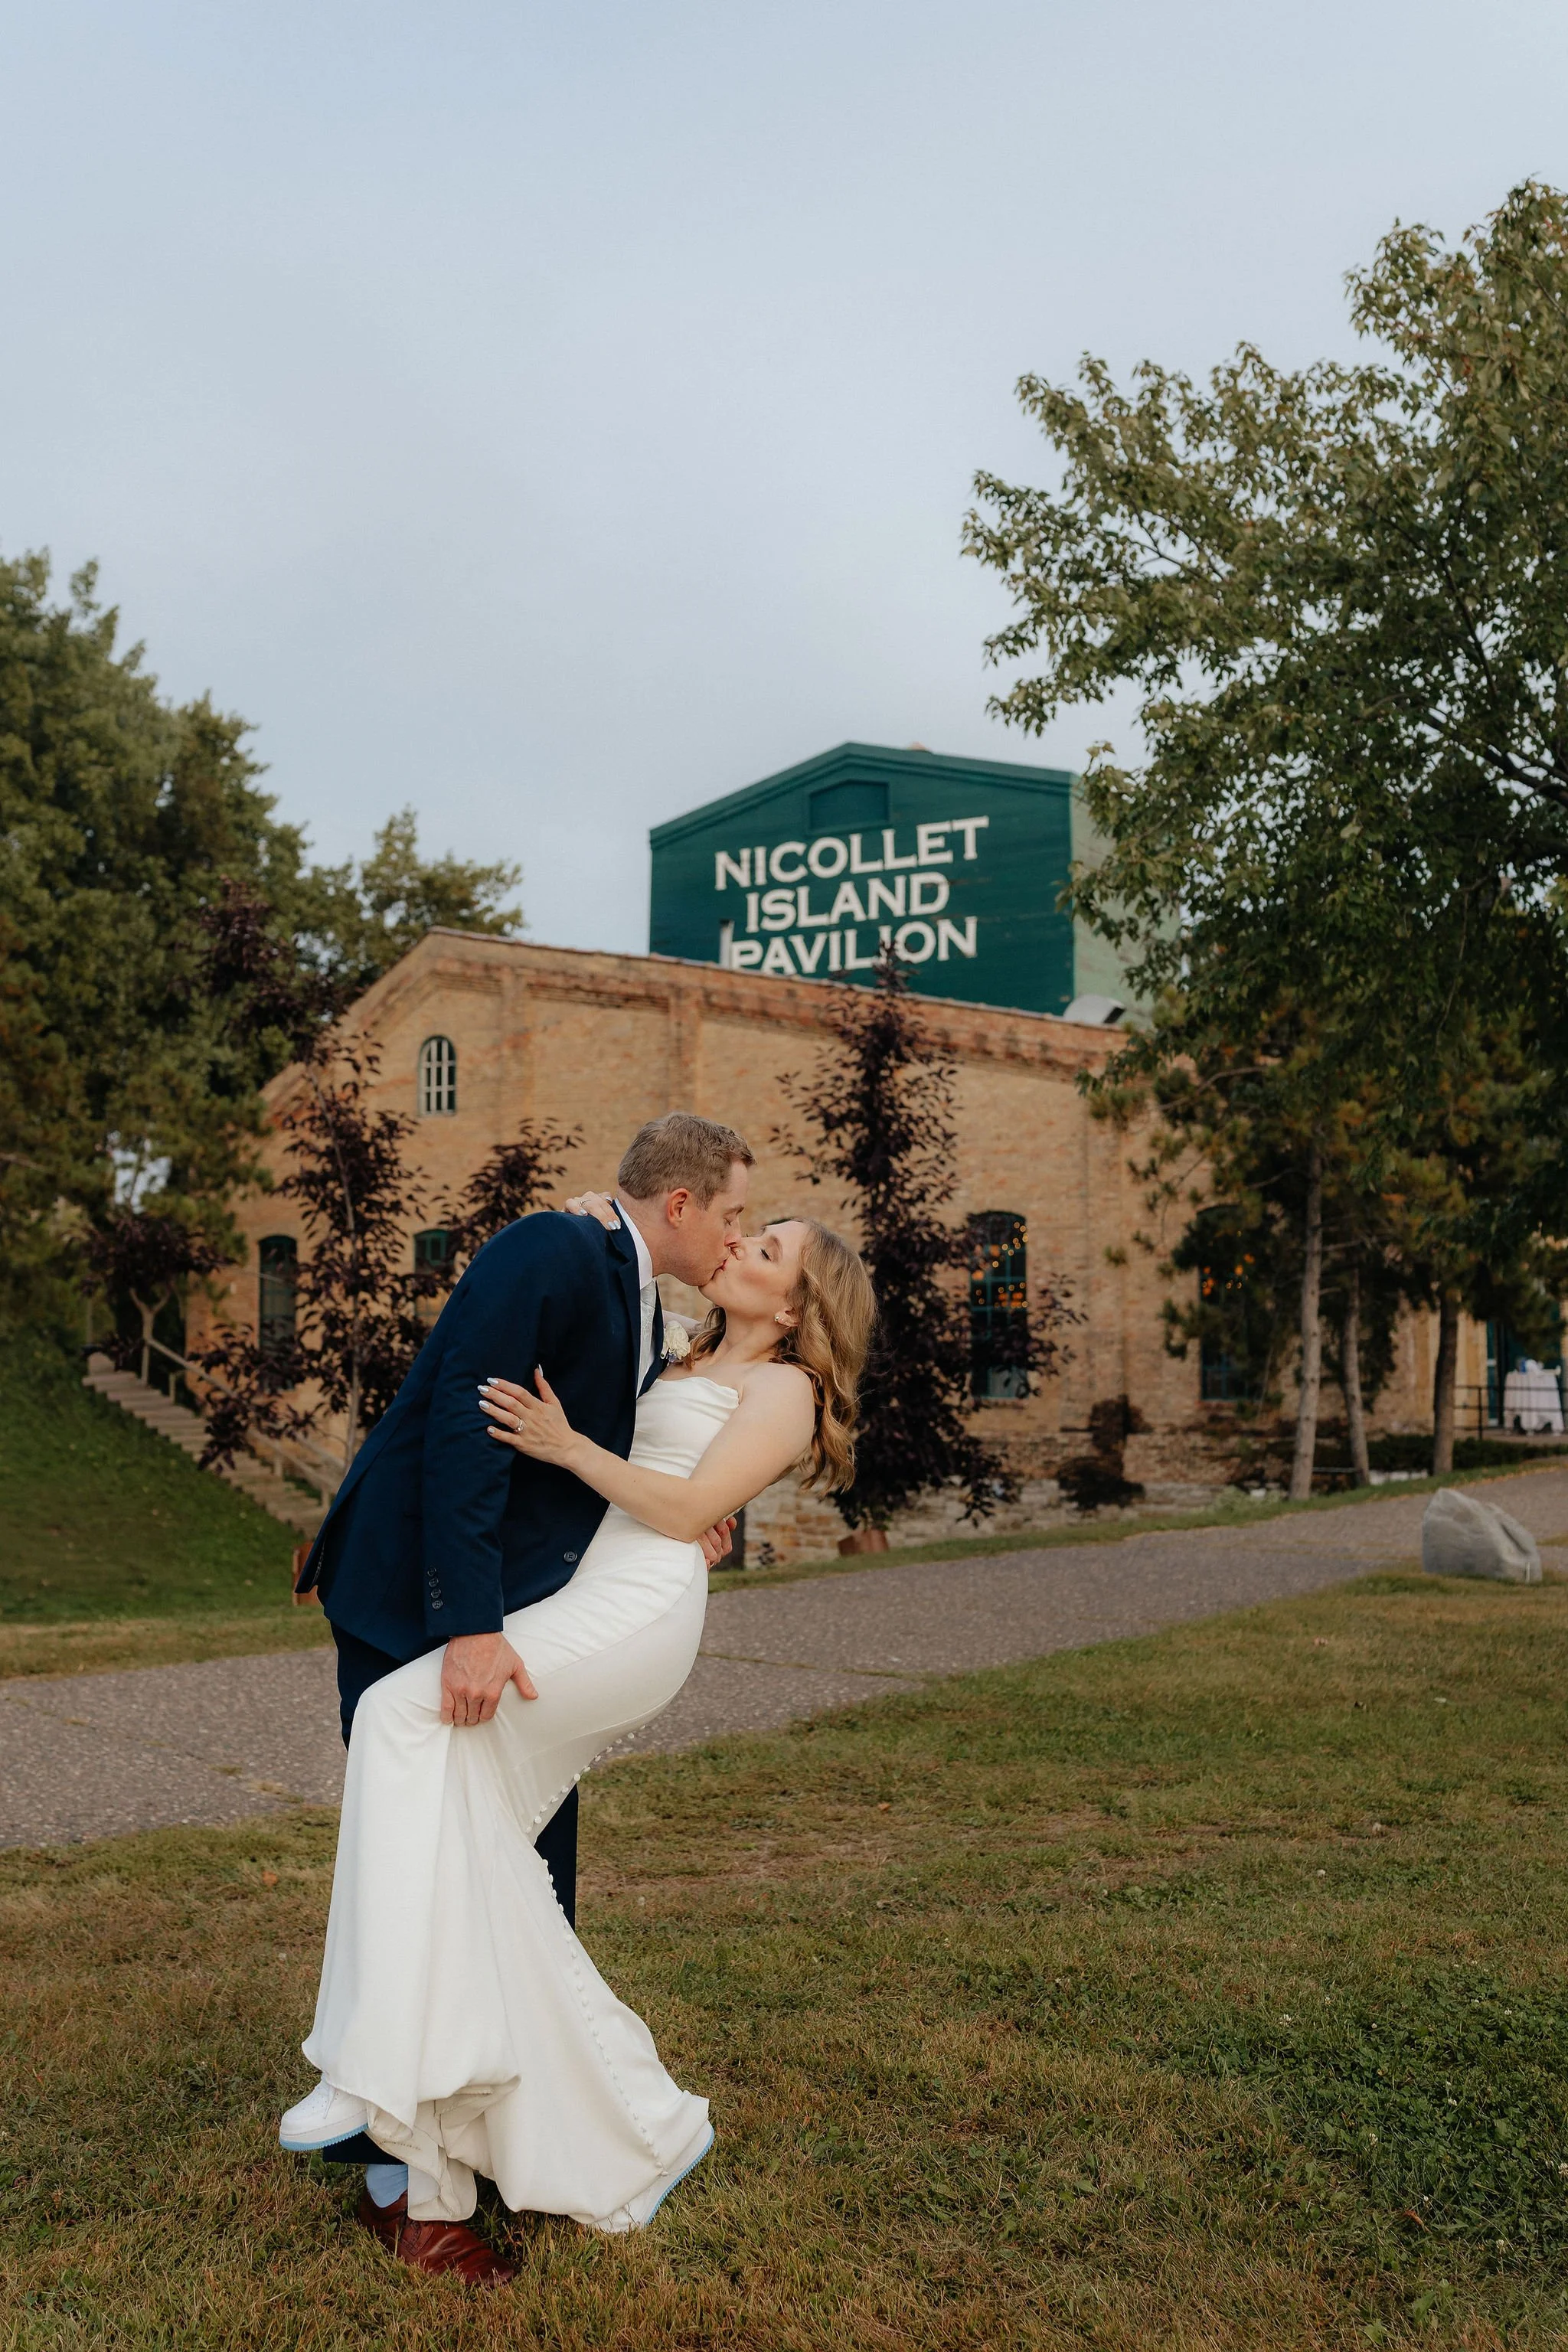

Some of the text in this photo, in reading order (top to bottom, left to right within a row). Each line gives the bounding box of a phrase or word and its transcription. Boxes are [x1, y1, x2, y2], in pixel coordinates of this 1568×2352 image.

[715, 816, 989, 890] NICOLLET
[746, 872, 949, 933] ISLAND
[731, 916, 977, 975] PAVILION
